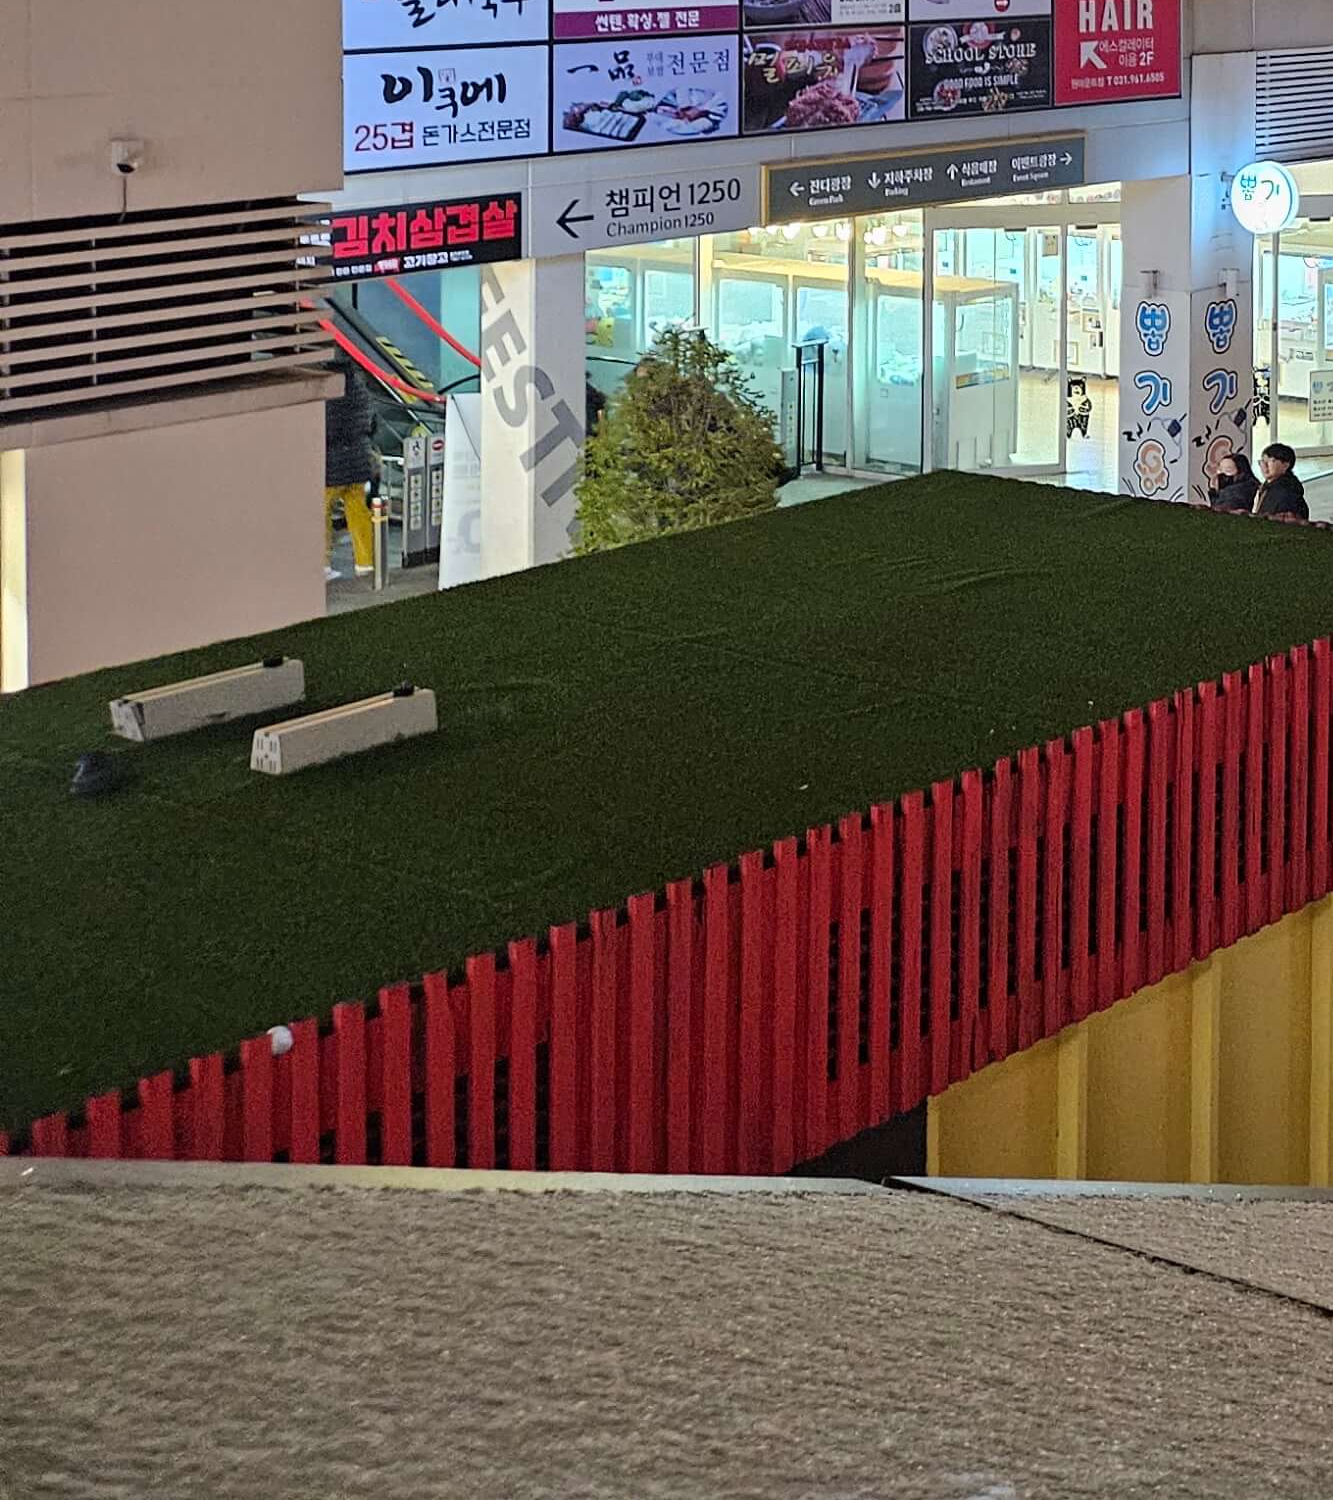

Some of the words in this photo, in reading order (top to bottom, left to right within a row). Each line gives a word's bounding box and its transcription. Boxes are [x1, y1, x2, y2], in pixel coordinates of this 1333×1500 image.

[1099, 37, 1154, 53] 에스컬레이터
[1139, 52, 1154, 66] 2F
[669, 49, 730, 76] 전문점
[355, 121, 414, 152] 25겹
[423, 119, 530, 146] 돈가스전문점
[884, 167, 933, 185] 지하주차장
[1240, 174, 1280, 201] 뽑기
[605, 184, 683, 218] 챔피언
[687, 179, 741, 207] 1250
[332, 199, 518, 259] 김치삼겹살
[606, 219, 682, 239] Champion
[684, 211, 715, 230] 1250
[1134, 301, 1172, 415] 뽑기
[1203, 299, 1238, 414] 뽑기
